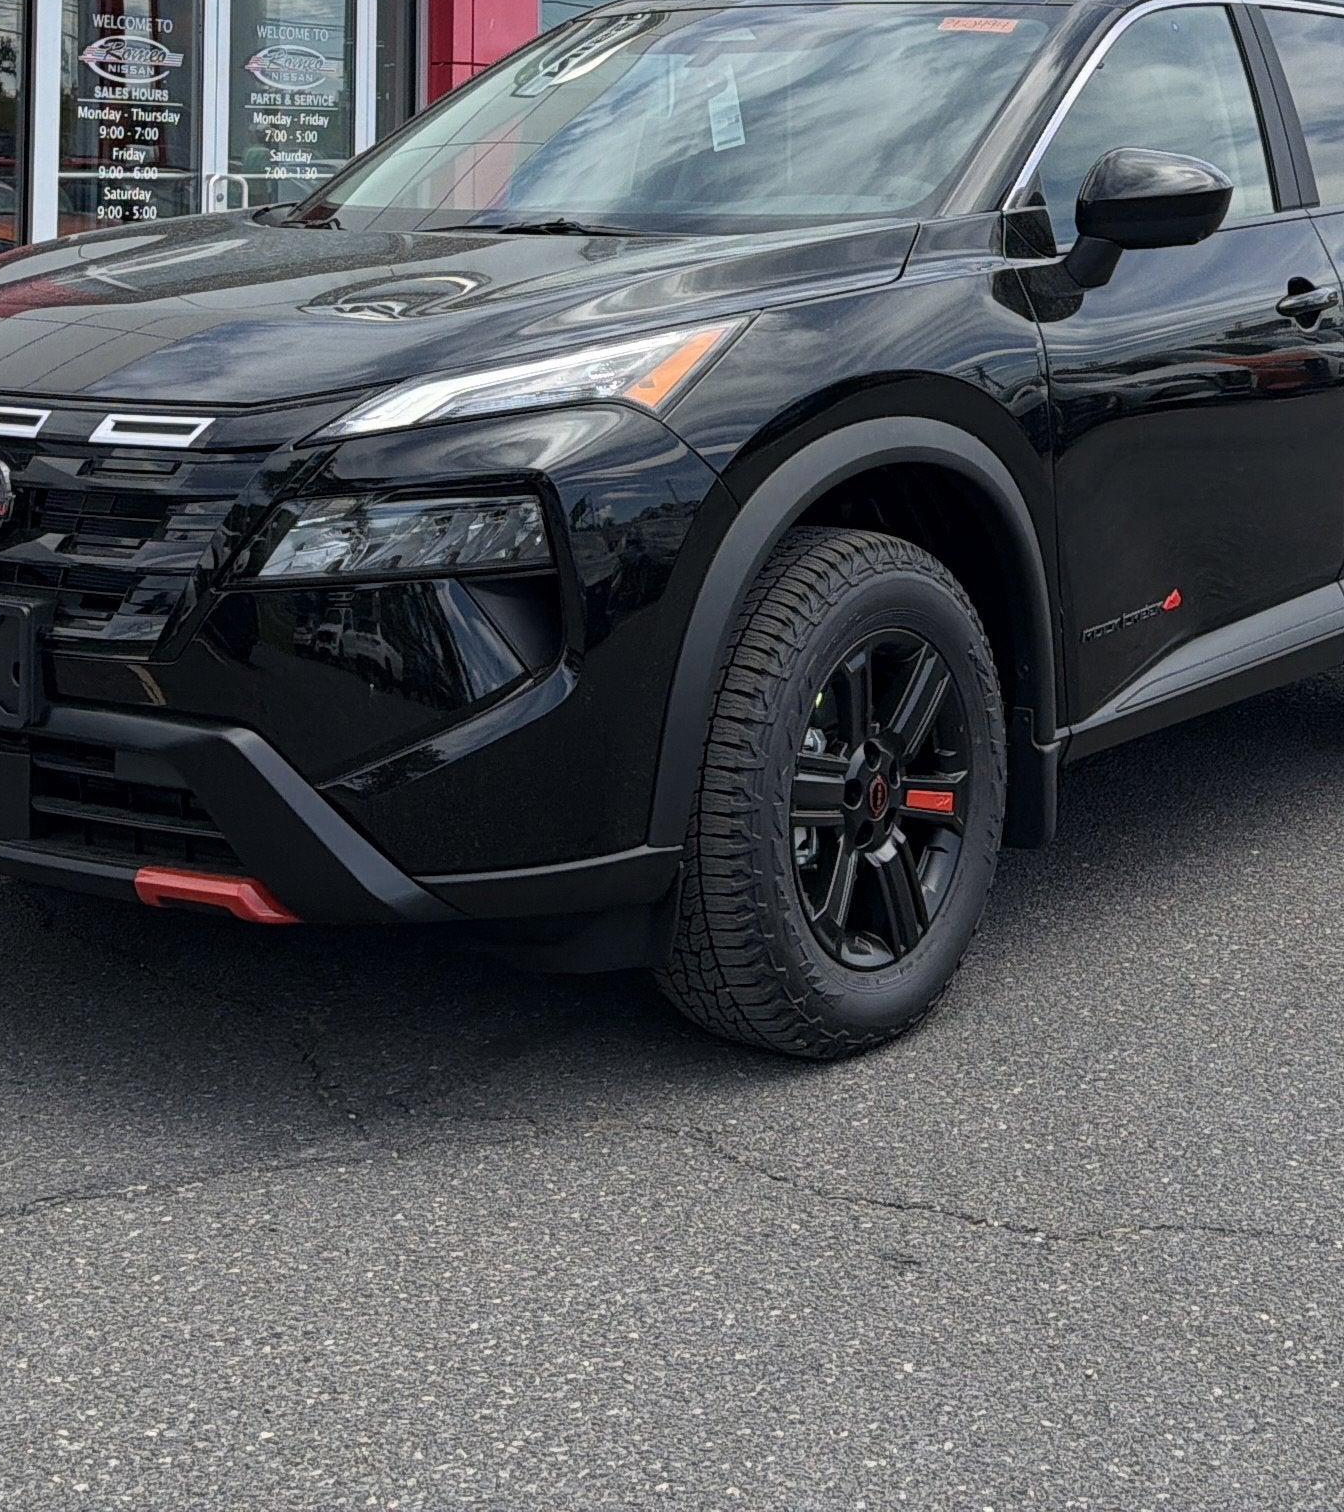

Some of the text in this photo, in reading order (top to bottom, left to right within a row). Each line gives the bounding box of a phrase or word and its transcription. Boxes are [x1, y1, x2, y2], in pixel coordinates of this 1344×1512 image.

[92, 13, 173, 33] WELCOME TO
[256, 25, 329, 41] WELCOME TO
[101, 39, 168, 65] Romeo
[265, 47, 325, 72] Romeo
[107, 64, 155, 76] NISSAN
[271, 73, 314, 82] NISSAN
[94, 86, 169, 102] SALES HOURS
[251, 93, 335, 107] PARTS & SERVICE
[77, 106, 122, 123] Monday
[131, 108, 181, 125] Thursday
[253, 112, 292, 127] Monday
[300, 113, 330, 128] Friday
[99, 126, 125, 140] 9:00
[134, 127, 159, 141] 7:00
[264, 130, 287, 142] 7:00
[296, 131, 318, 143] 5:00
[112, 148, 146, 164] Friday
[269, 149, 313, 163] Saturday
[98, 166, 124, 180] 9:00
[133, 167, 159, 180] 6:00
[264, 167, 287, 179] 7:00
[296, 167, 318, 179] 1:30
[104, 187, 152, 202] Saturday
[97, 205, 123, 219] 9:00
[132, 206, 157, 220] 5:00
